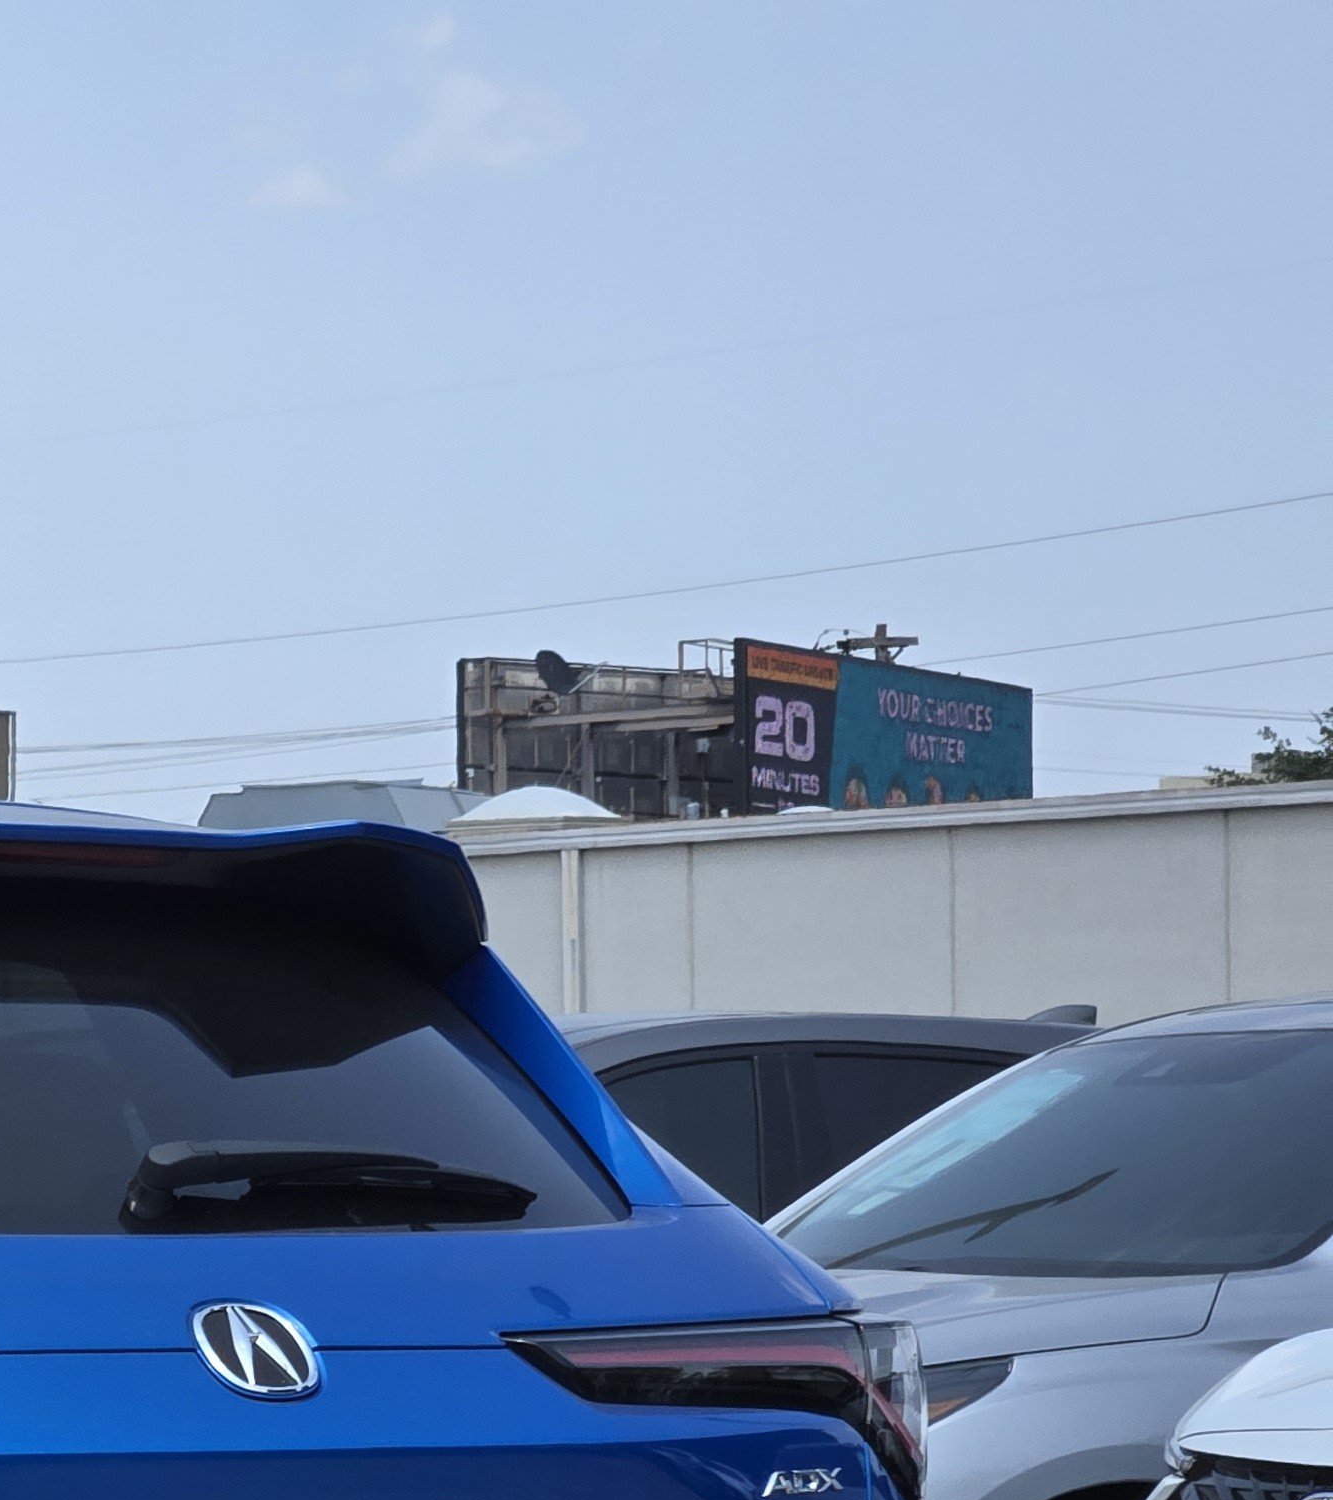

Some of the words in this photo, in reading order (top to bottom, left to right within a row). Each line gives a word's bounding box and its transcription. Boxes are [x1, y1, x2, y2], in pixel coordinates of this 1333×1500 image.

[877, 687, 921, 722] YOUR
[924, 698, 993, 732] CHOICES
[754, 695, 815, 762] 20
[906, 731, 966, 764] MATTER
[751, 766, 819, 796] MINUTES
[761, 1467, 843, 1498] ADX
